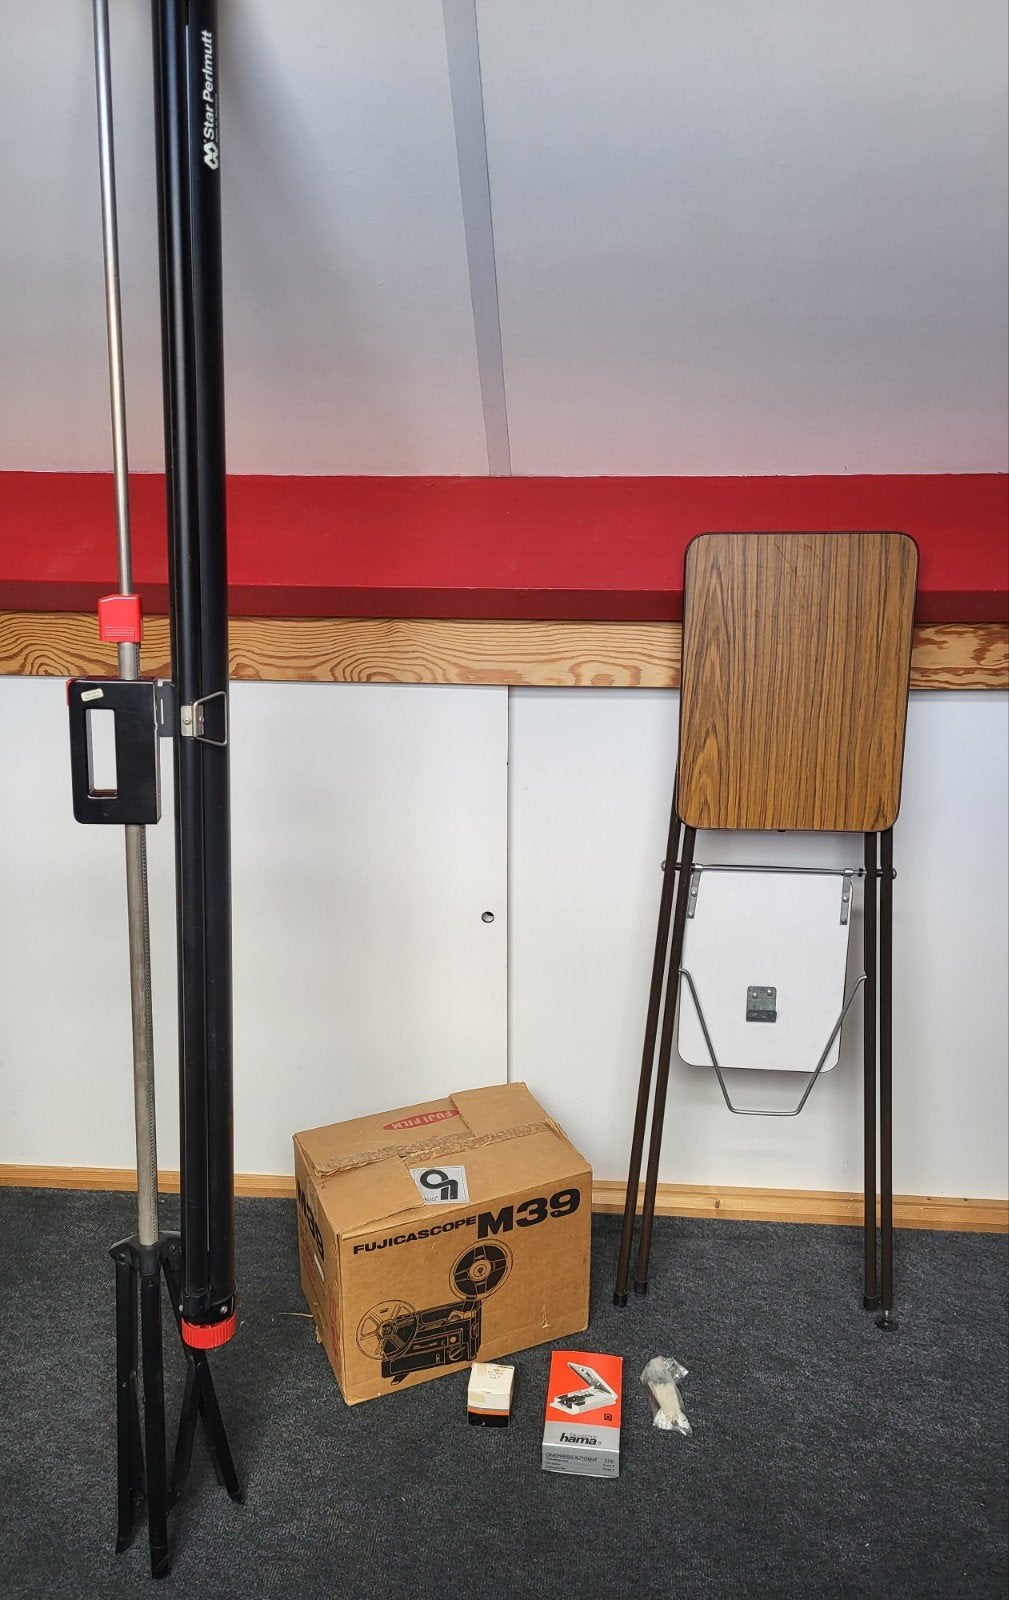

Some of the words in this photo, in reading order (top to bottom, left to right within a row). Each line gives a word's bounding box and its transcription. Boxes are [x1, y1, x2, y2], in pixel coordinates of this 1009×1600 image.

[201, 30, 214, 103] Perlmutt
[203, 103, 215, 141] Star
[392, 1117, 421, 1130] FILM
[422, 1110, 453, 1122] FUJI
[353, 1214, 477, 1255] FUJICASCOPE
[477, 1188, 581, 1239] M39
[559, 1432, 597, 1446] hama
